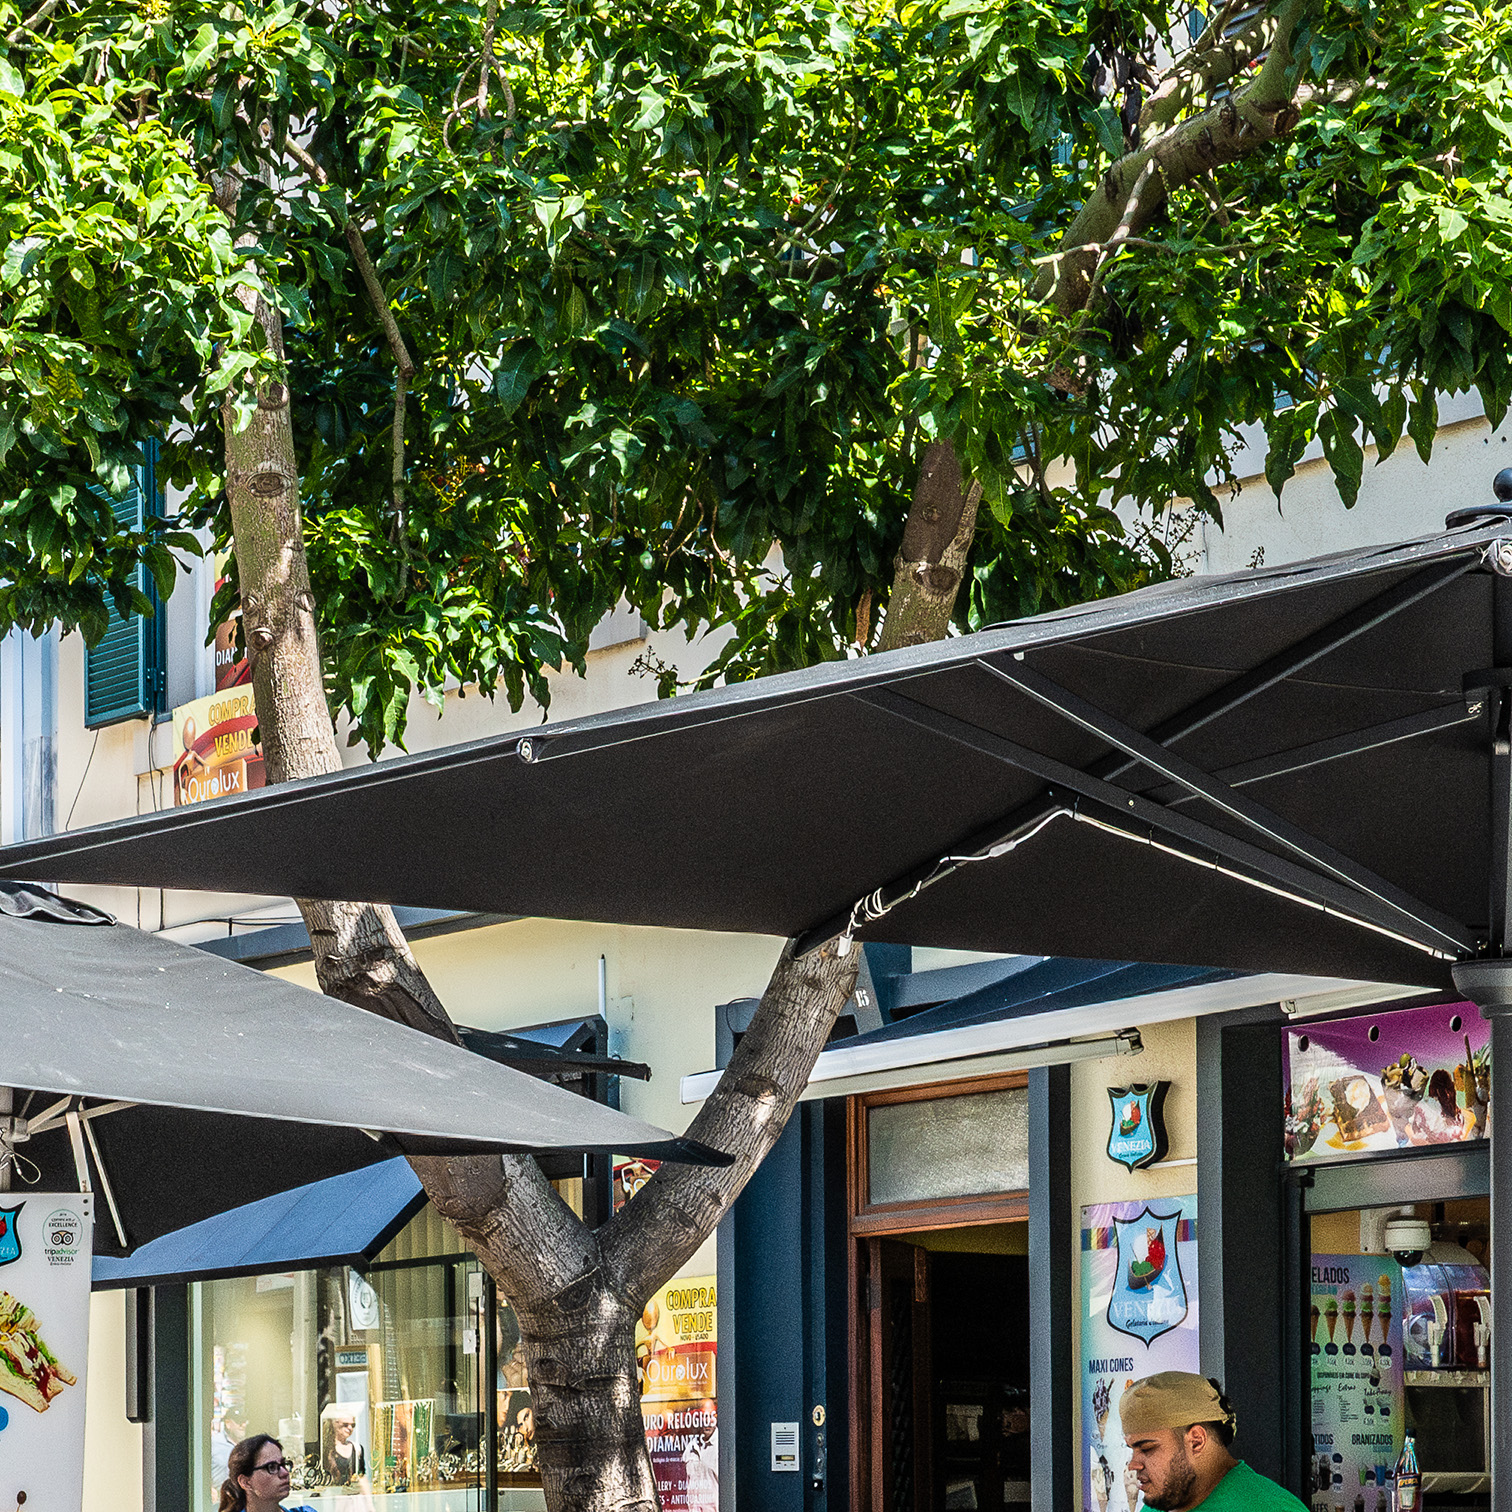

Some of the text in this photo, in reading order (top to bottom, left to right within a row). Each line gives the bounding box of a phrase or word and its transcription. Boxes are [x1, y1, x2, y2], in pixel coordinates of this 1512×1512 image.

[188, 769, 240, 802] Ourolux
[1110, 1138, 1151, 1153] VENEZIA
[666, 1286, 717, 1311] COMPRA
[672, 1311, 713, 1335] VENDE
[647, 1357, 709, 1382] Ourolux
[1088, 1357, 1134, 1374] MAXI CONES
[667, 1408, 717, 1430] RELÓGIOS
[648, 1433, 705, 1453] DIAMANTES
[1352, 1434, 1393, 1446] GRANIZADOS
